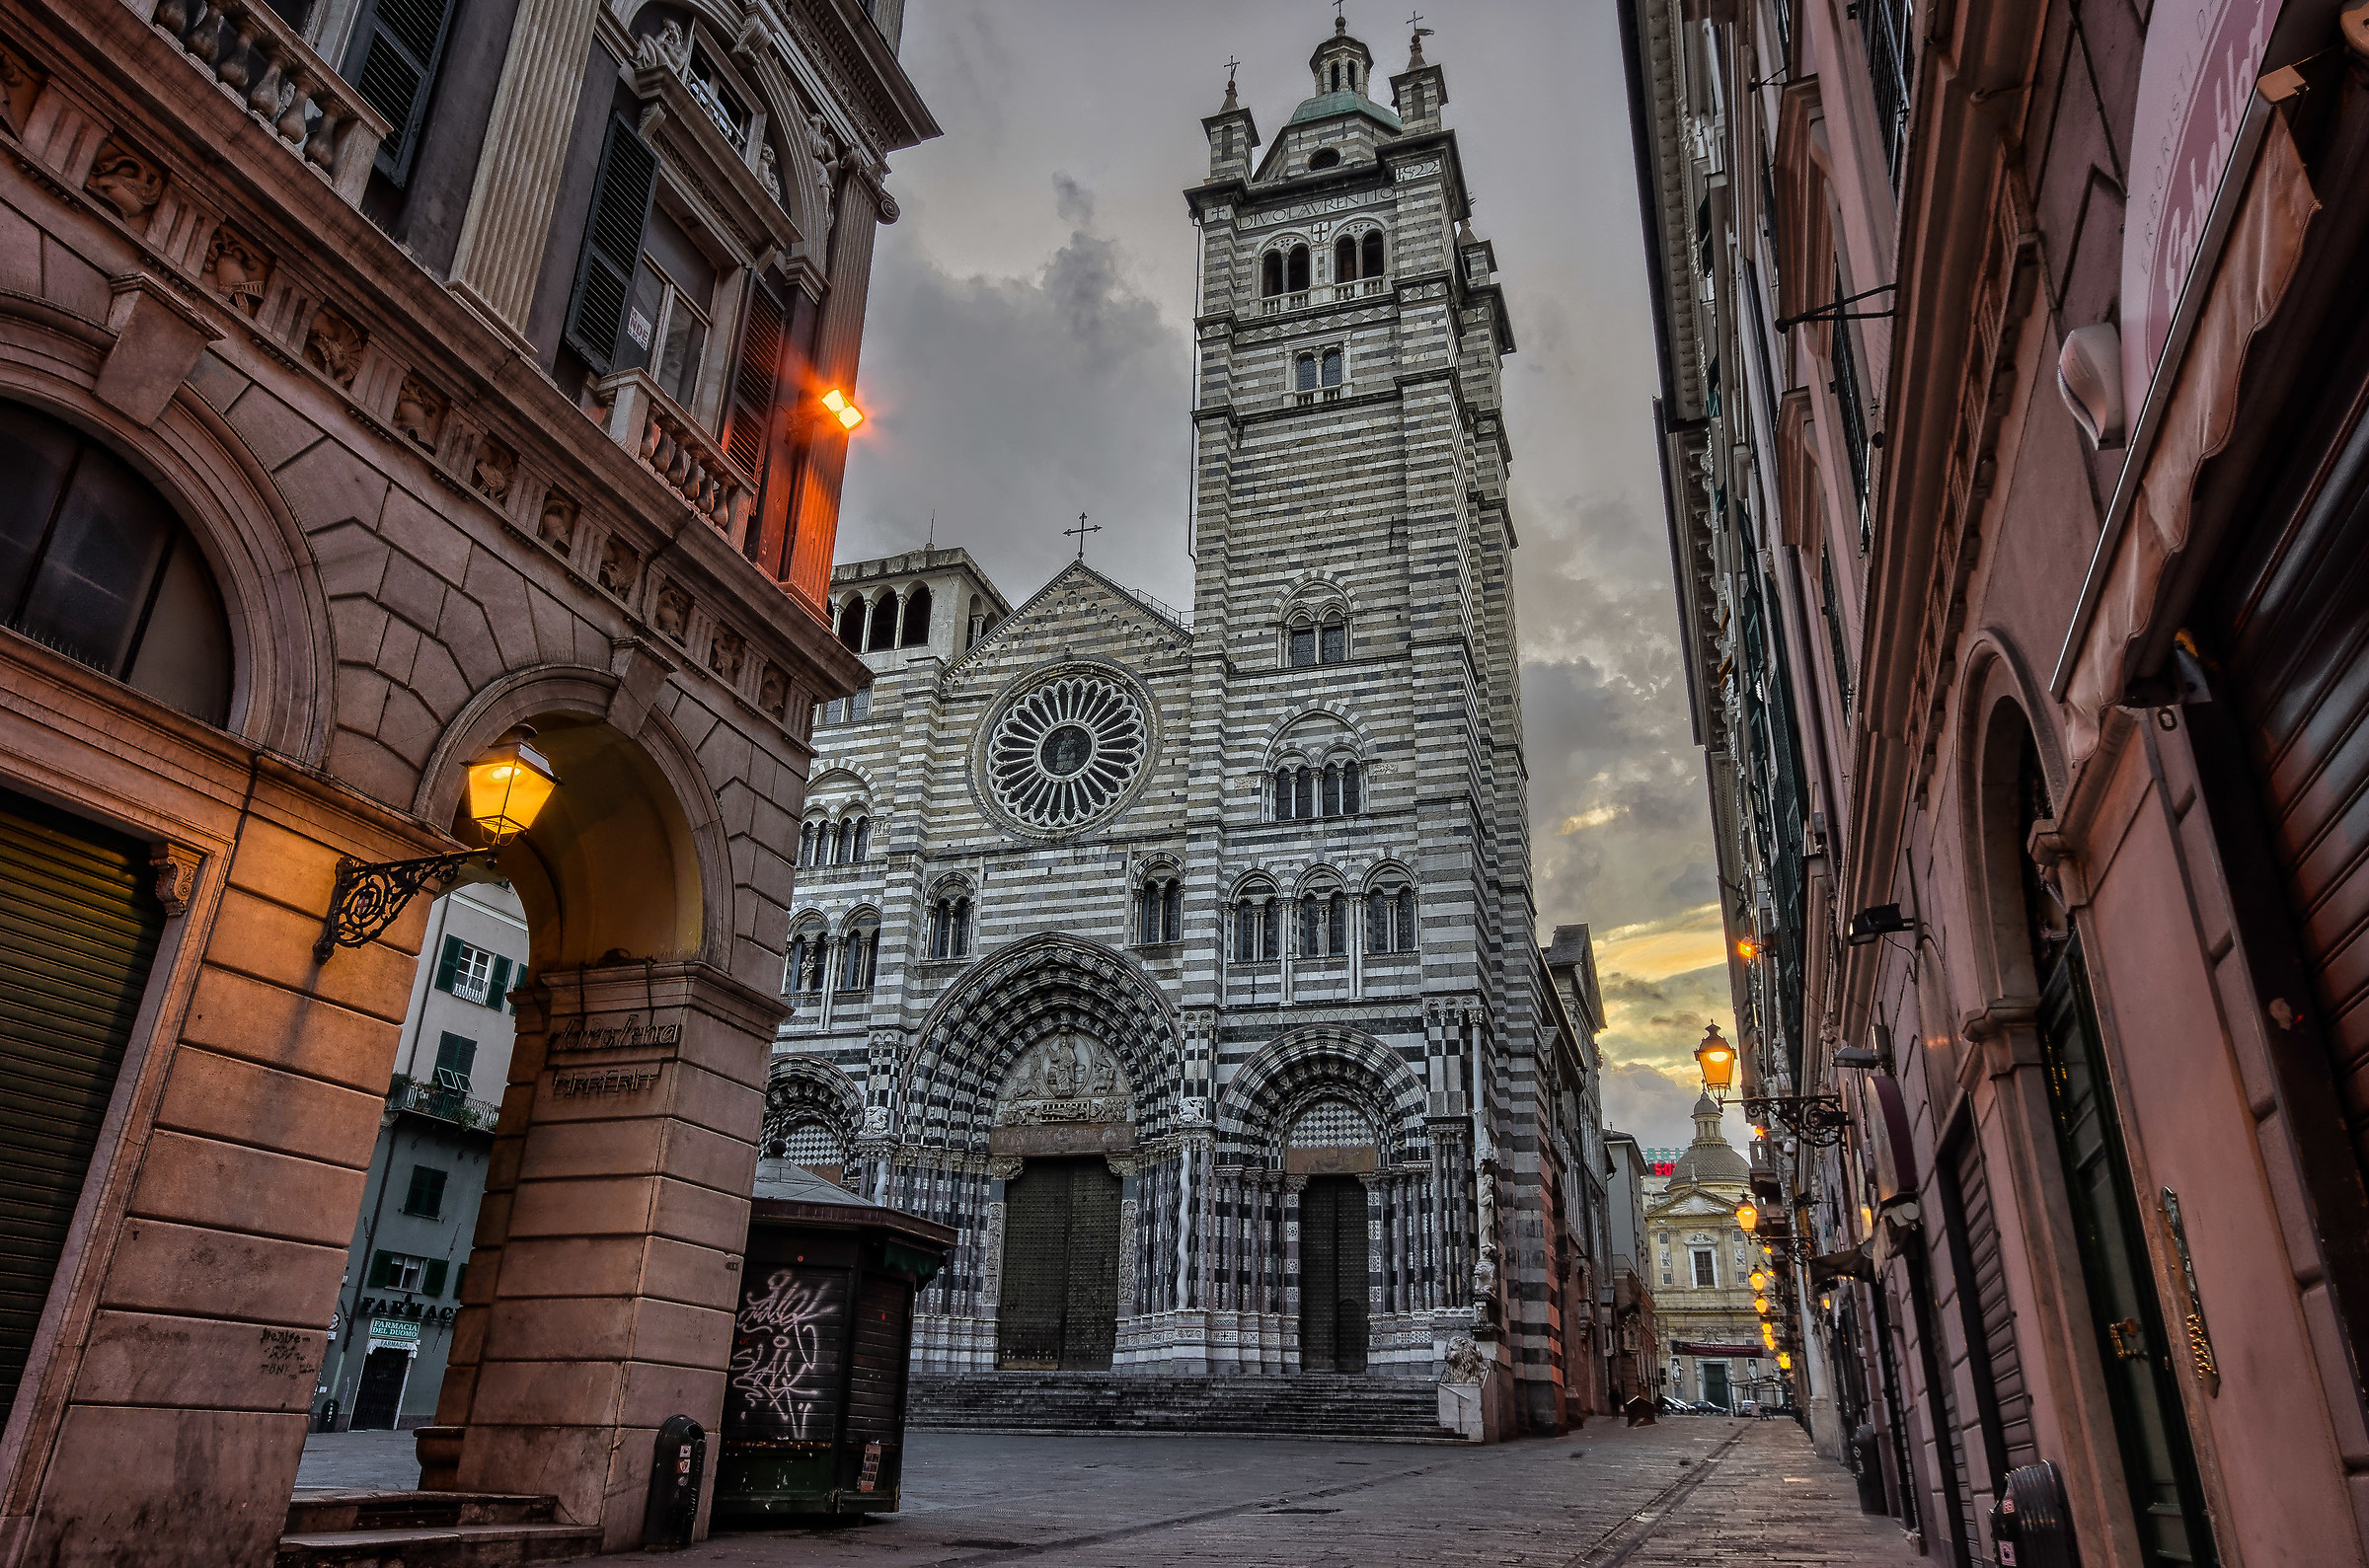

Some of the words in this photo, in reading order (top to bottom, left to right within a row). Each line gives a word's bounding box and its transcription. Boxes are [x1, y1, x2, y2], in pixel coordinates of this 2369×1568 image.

[2140, 50, 2192, 275] ERBORISTI
[362, 1297, 457, 1320] FARMAC
[374, 1320, 418, 1331] FARMACIA
[390, 1329, 418, 1338] DUOMO
